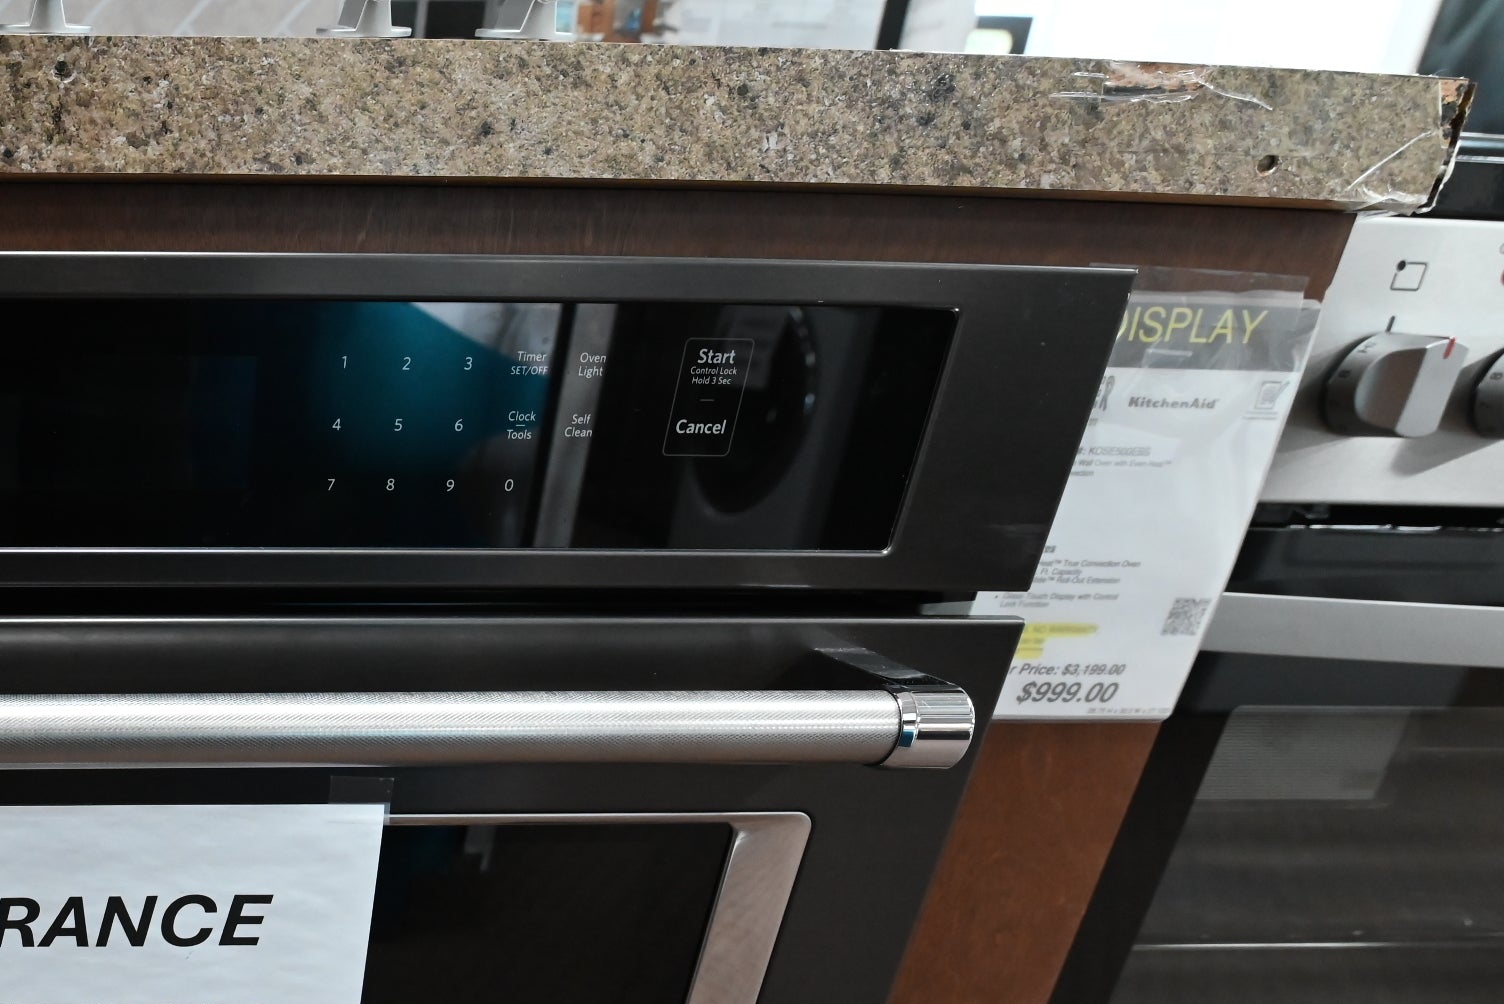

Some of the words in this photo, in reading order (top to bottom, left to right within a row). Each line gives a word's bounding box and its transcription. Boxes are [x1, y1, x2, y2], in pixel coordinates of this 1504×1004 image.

[341, 355, 348, 369] 1
[517, 351, 547, 363] Timer
[579, 353, 607, 364] Oven
[697, 348, 736, 365] Start
[402, 356, 411, 371] 2
[463, 356, 473, 371] 3
[510, 365, 549, 376] SET/OFF
[578, 365, 604, 378] Light
[690, 366, 718, 375] Control
[719, 366, 738, 375] Lock
[691, 376, 710, 385] Hold
[718, 376, 732, 385] Sec
[1128, 396, 1217, 409] KitchenAid
[508, 410, 537, 422] Clock
[571, 413, 592, 425] Self
[332, 418, 342, 431] 4
[393, 418, 403, 432] 5
[454, 418, 464, 432] 6
[675, 418, 727, 435] Cancel
[506, 429, 532, 440] Tools
[564, 426, 593, 438] Clean
[327, 478, 336, 491] 7
[385, 478, 395, 491] 8
[446, 479, 455, 492] 9
[504, 478, 514, 492] 0
[1018, 663, 1059, 676] Price:
[1016, 681, 1119, 705] $999.00
